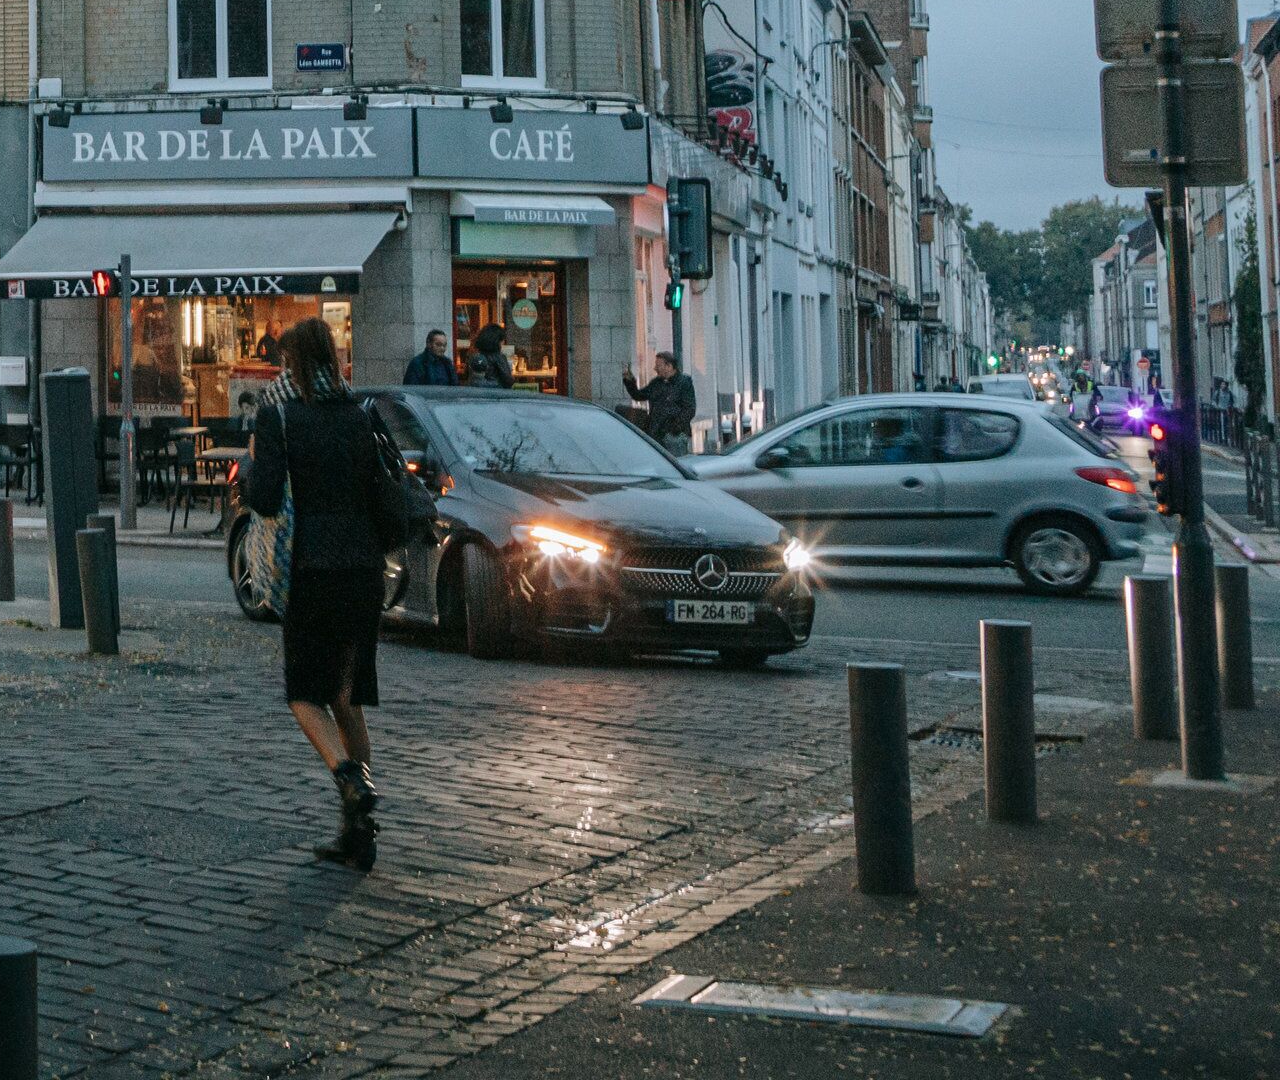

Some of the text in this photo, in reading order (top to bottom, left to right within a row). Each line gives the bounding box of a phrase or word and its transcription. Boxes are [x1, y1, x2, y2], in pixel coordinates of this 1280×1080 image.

[313, 59, 342, 67] GAMBETTA
[72, 126, 377, 162] BAR DE LA PAIX
[490, 123, 575, 162] CAFÉ
[504, 209, 588, 223] BAR DE LA PAIX
[167, 277, 207, 296] LA
[215, 275, 286, 295] PAIX
[677, 603, 747, 620] FM-264-RG
